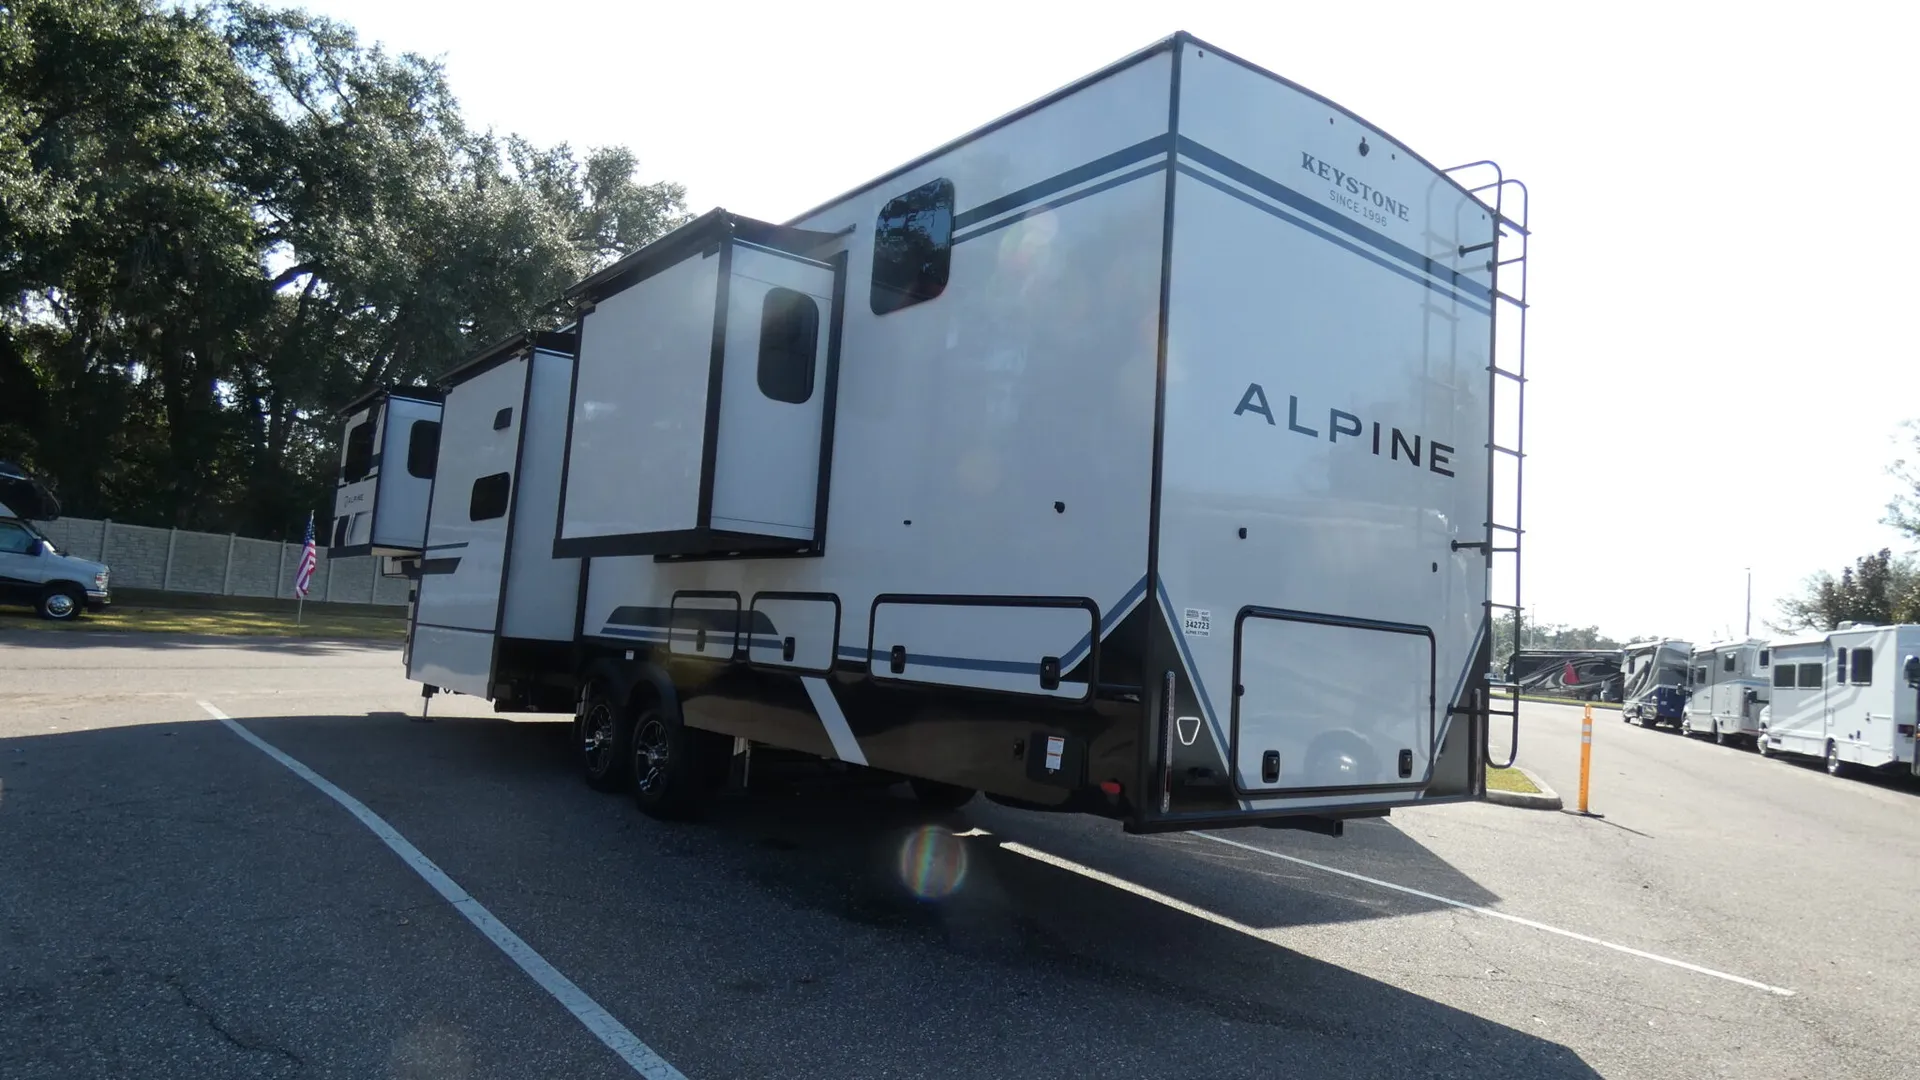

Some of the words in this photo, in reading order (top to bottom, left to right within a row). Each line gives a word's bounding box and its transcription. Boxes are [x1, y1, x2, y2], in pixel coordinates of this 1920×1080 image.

[1301, 151, 1409, 222] KEYSTONE
[1329, 189, 1360, 213] SINCE
[1362, 206, 1388, 227] 1996
[1233, 382, 1455, 478] ALPINE
[1185, 620, 1210, 630] 342723
